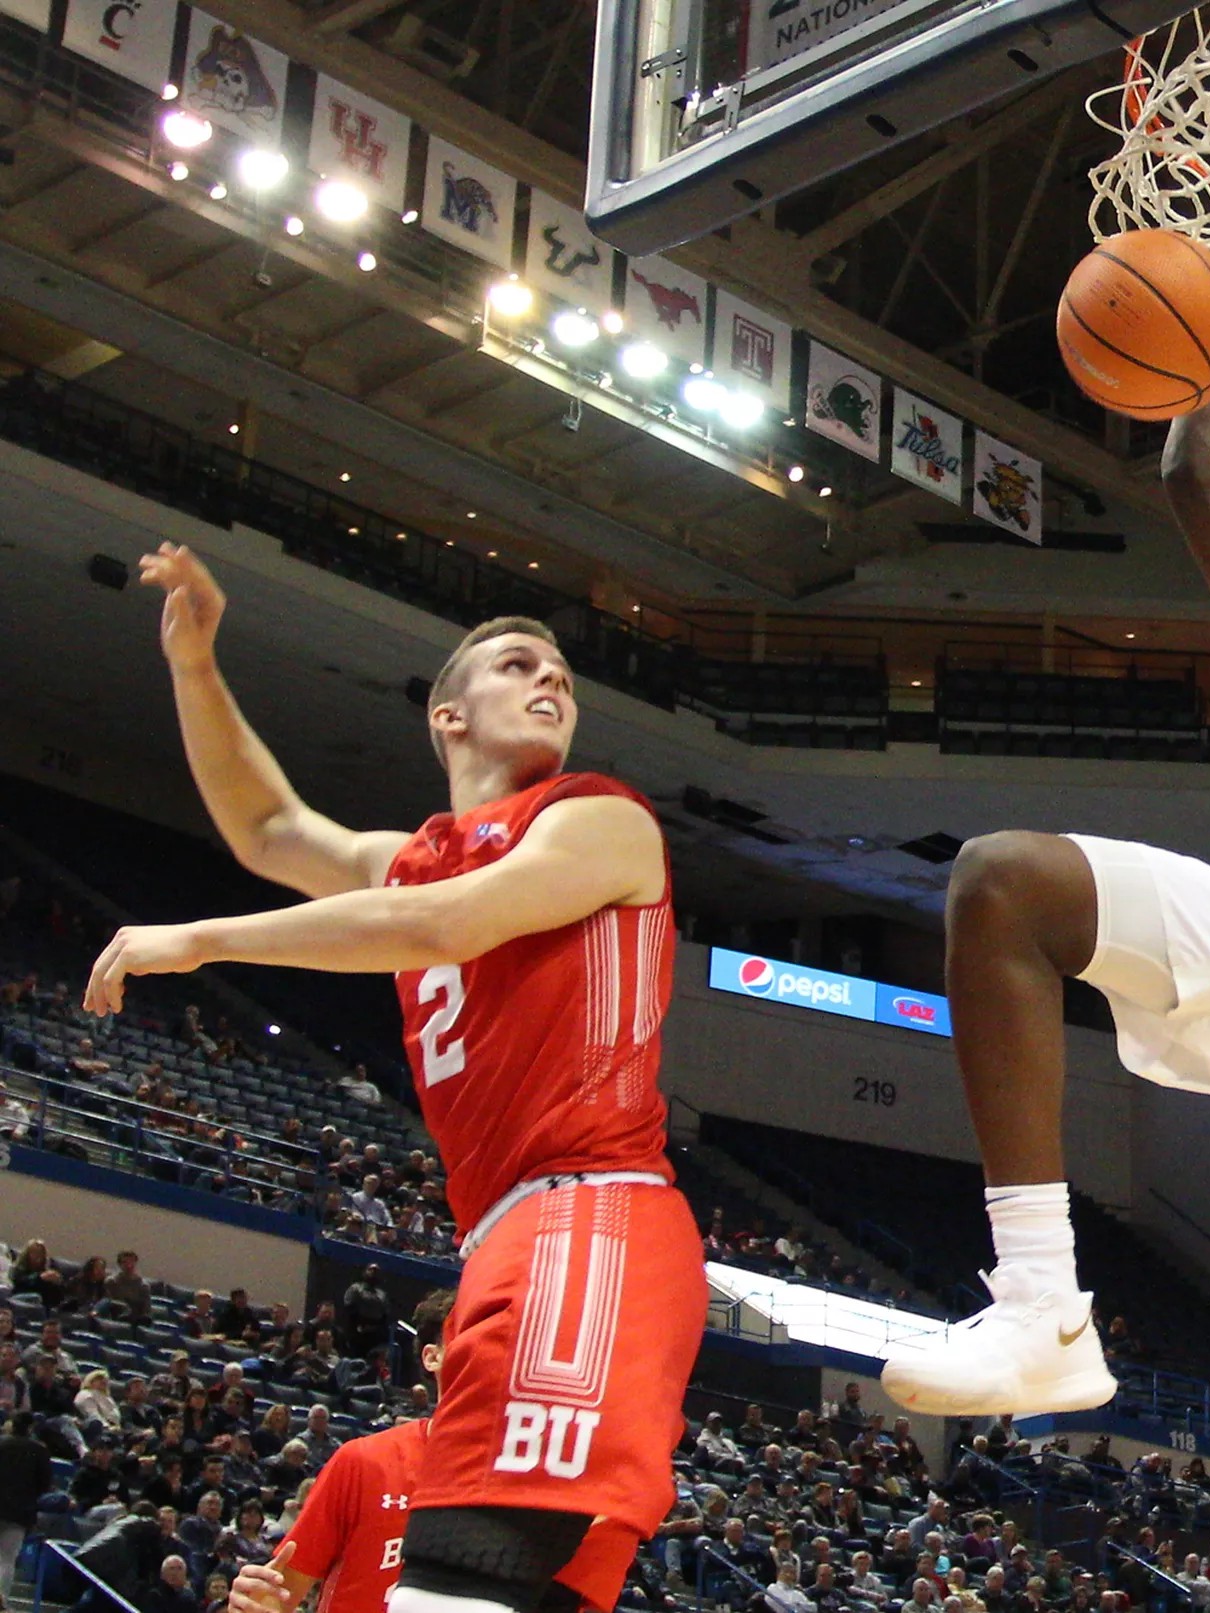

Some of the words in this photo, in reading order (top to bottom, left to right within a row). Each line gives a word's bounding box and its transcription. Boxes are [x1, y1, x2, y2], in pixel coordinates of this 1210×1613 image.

[778, 973, 852, 1005] pepsi
[417, 963, 466, 1089] 2
[854, 1076, 897, 1107] 219
[494, 1401, 600, 1479] BU
[1169, 1429, 1196, 1452] 118
